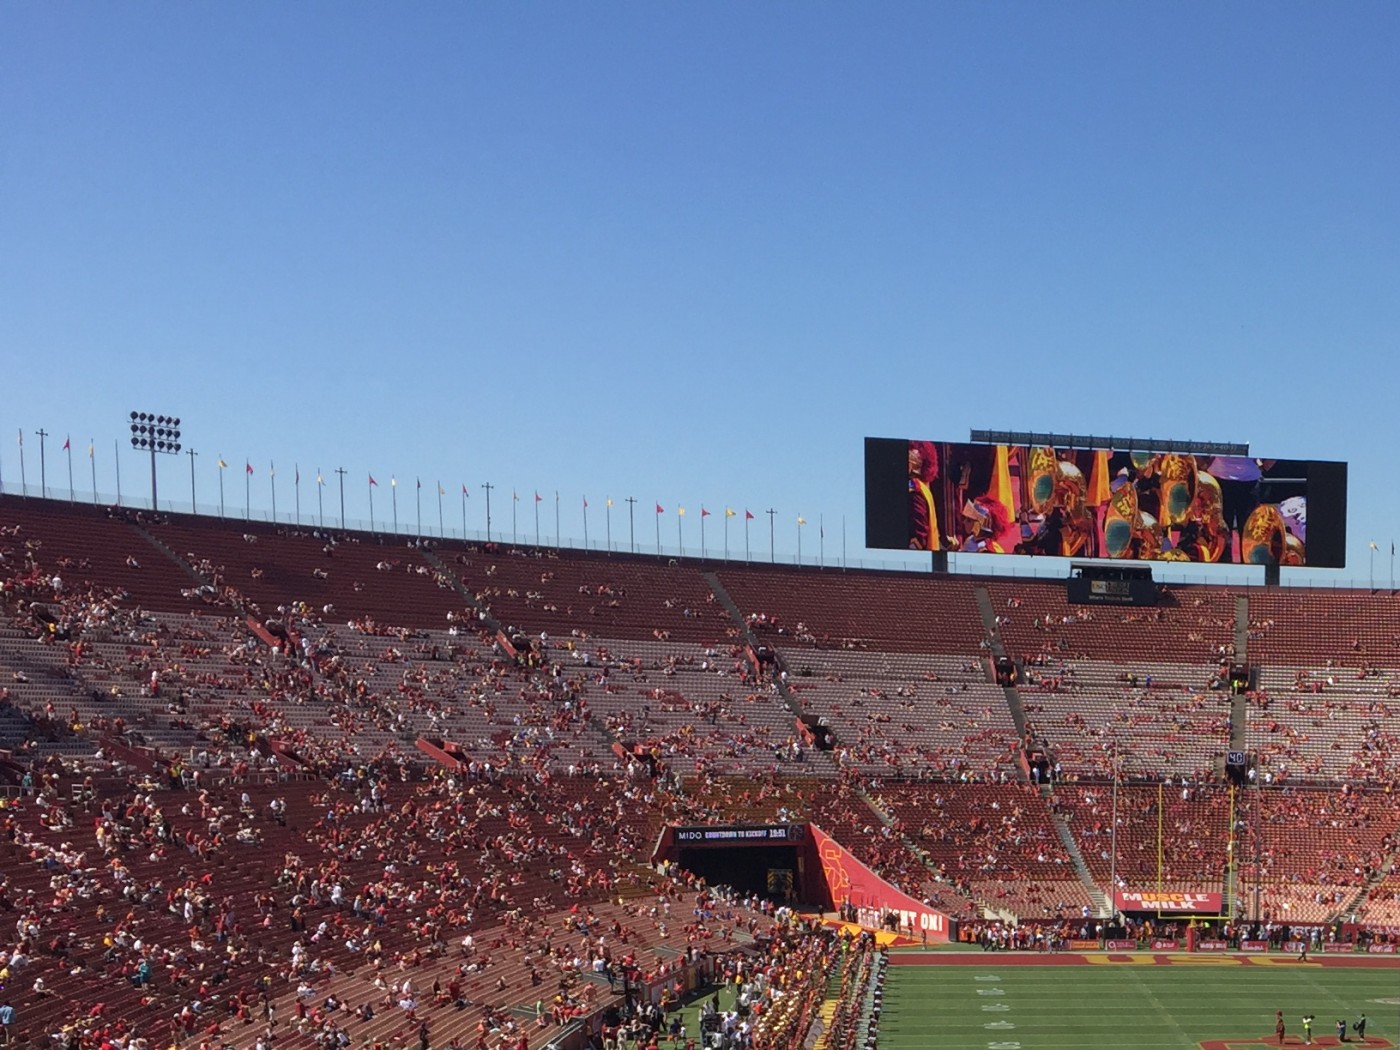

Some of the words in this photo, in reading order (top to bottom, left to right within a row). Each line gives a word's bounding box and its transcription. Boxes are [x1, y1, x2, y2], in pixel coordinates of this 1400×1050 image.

[678, 831, 702, 840] MIDO
[1122, 892, 1211, 903] MUSCLE
[1142, 901, 1196, 910] MILK
[920, 912, 943, 932] ON!
